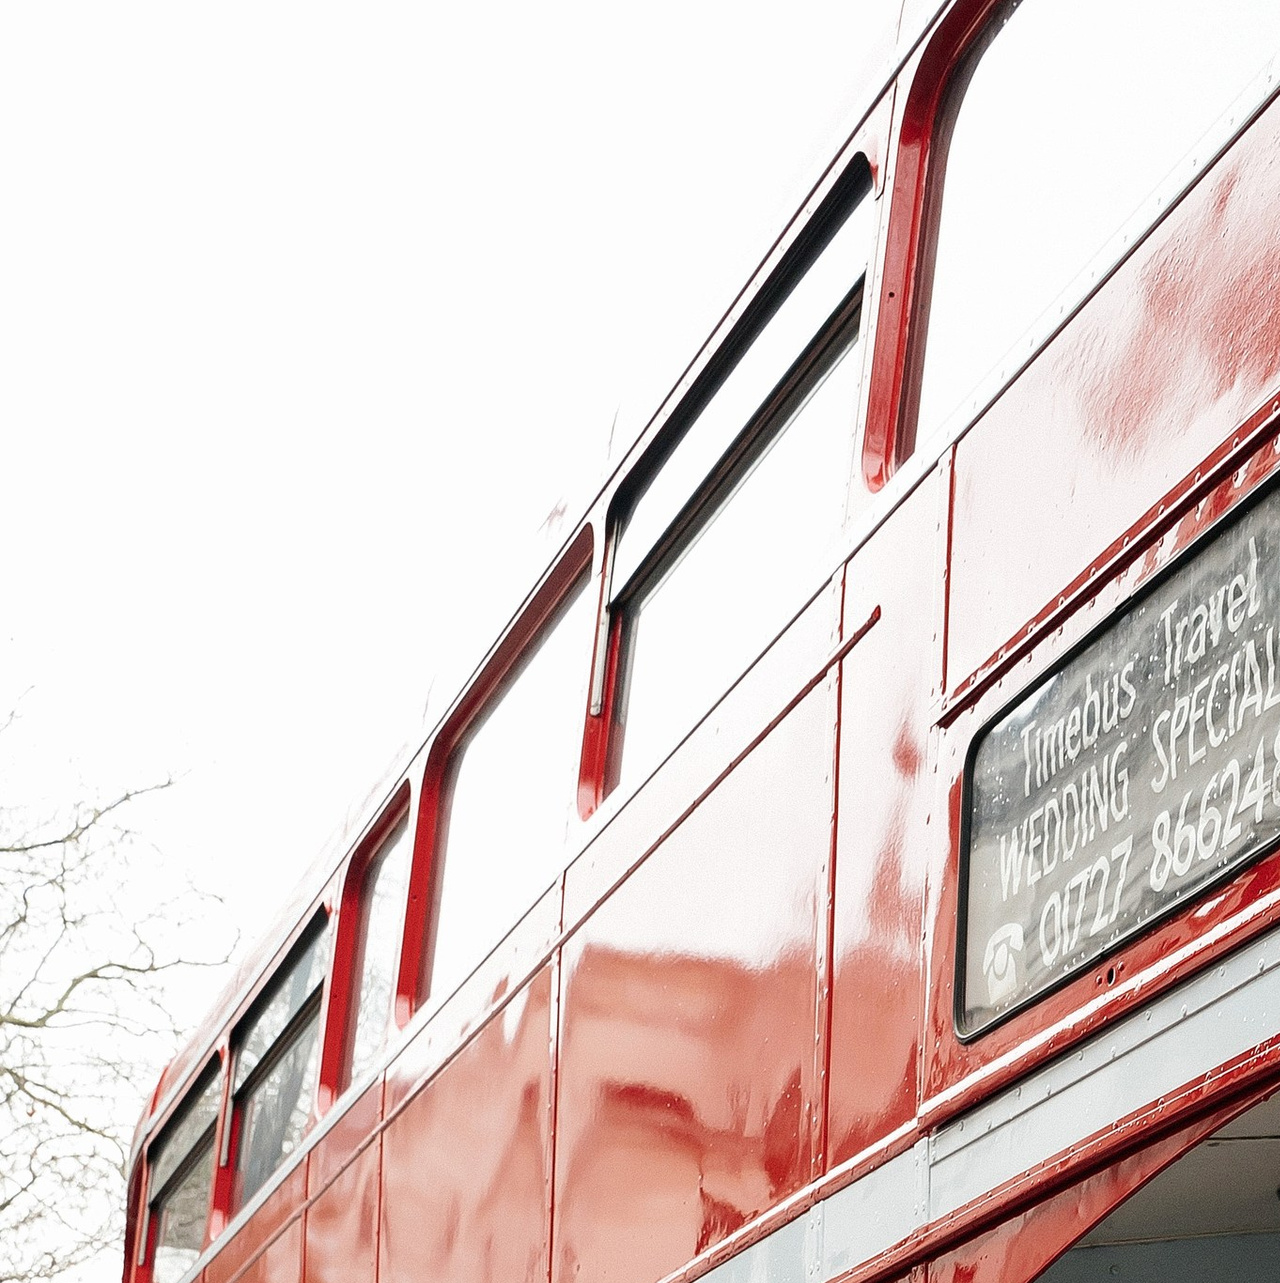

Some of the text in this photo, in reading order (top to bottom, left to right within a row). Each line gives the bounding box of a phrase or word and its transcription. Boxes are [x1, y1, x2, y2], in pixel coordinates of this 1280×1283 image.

[1020, 536, 1261, 798] Timebus Travel
[1000, 742, 1129, 901] WEDDING
[1039, 834, 1134, 967] 01727
